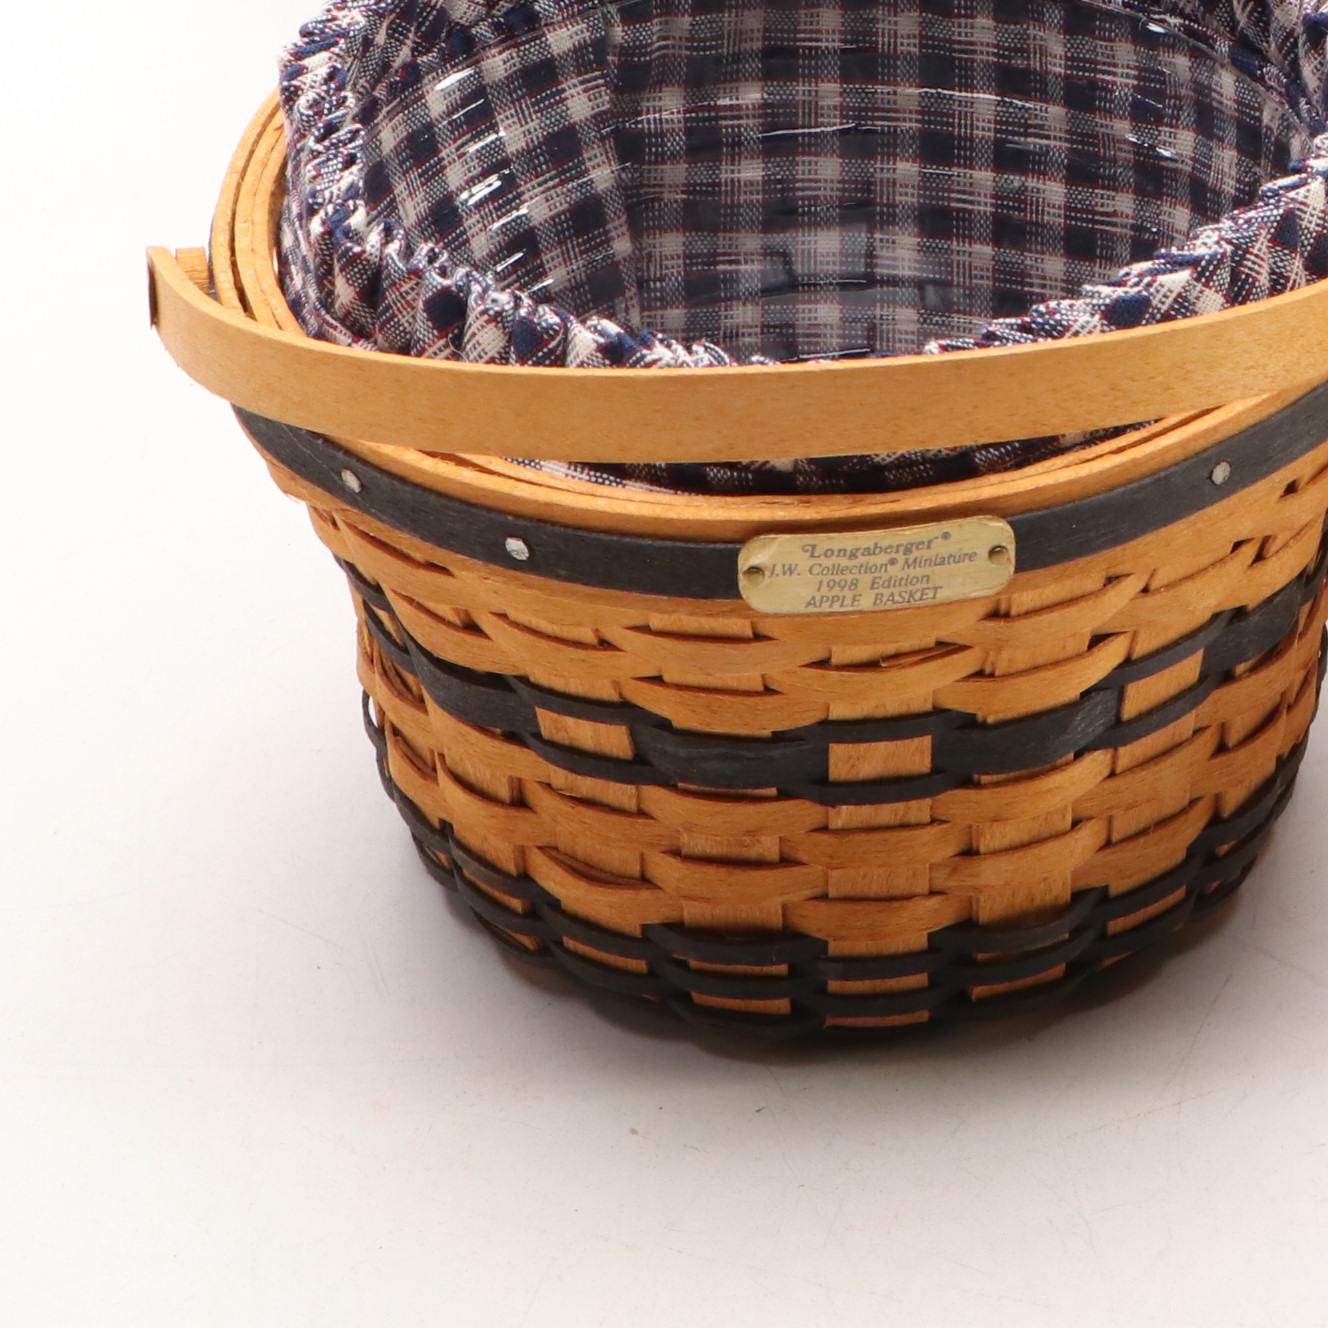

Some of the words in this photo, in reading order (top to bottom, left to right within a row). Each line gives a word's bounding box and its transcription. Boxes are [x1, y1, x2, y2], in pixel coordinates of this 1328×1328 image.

[768, 563, 801, 579] J.W.
[901, 549, 978, 572] Miniature
[816, 578, 859, 593] 1998
[869, 573, 931, 591] Edition
[805, 593, 862, 609] APPLE
[872, 585, 943, 607] BASKET
